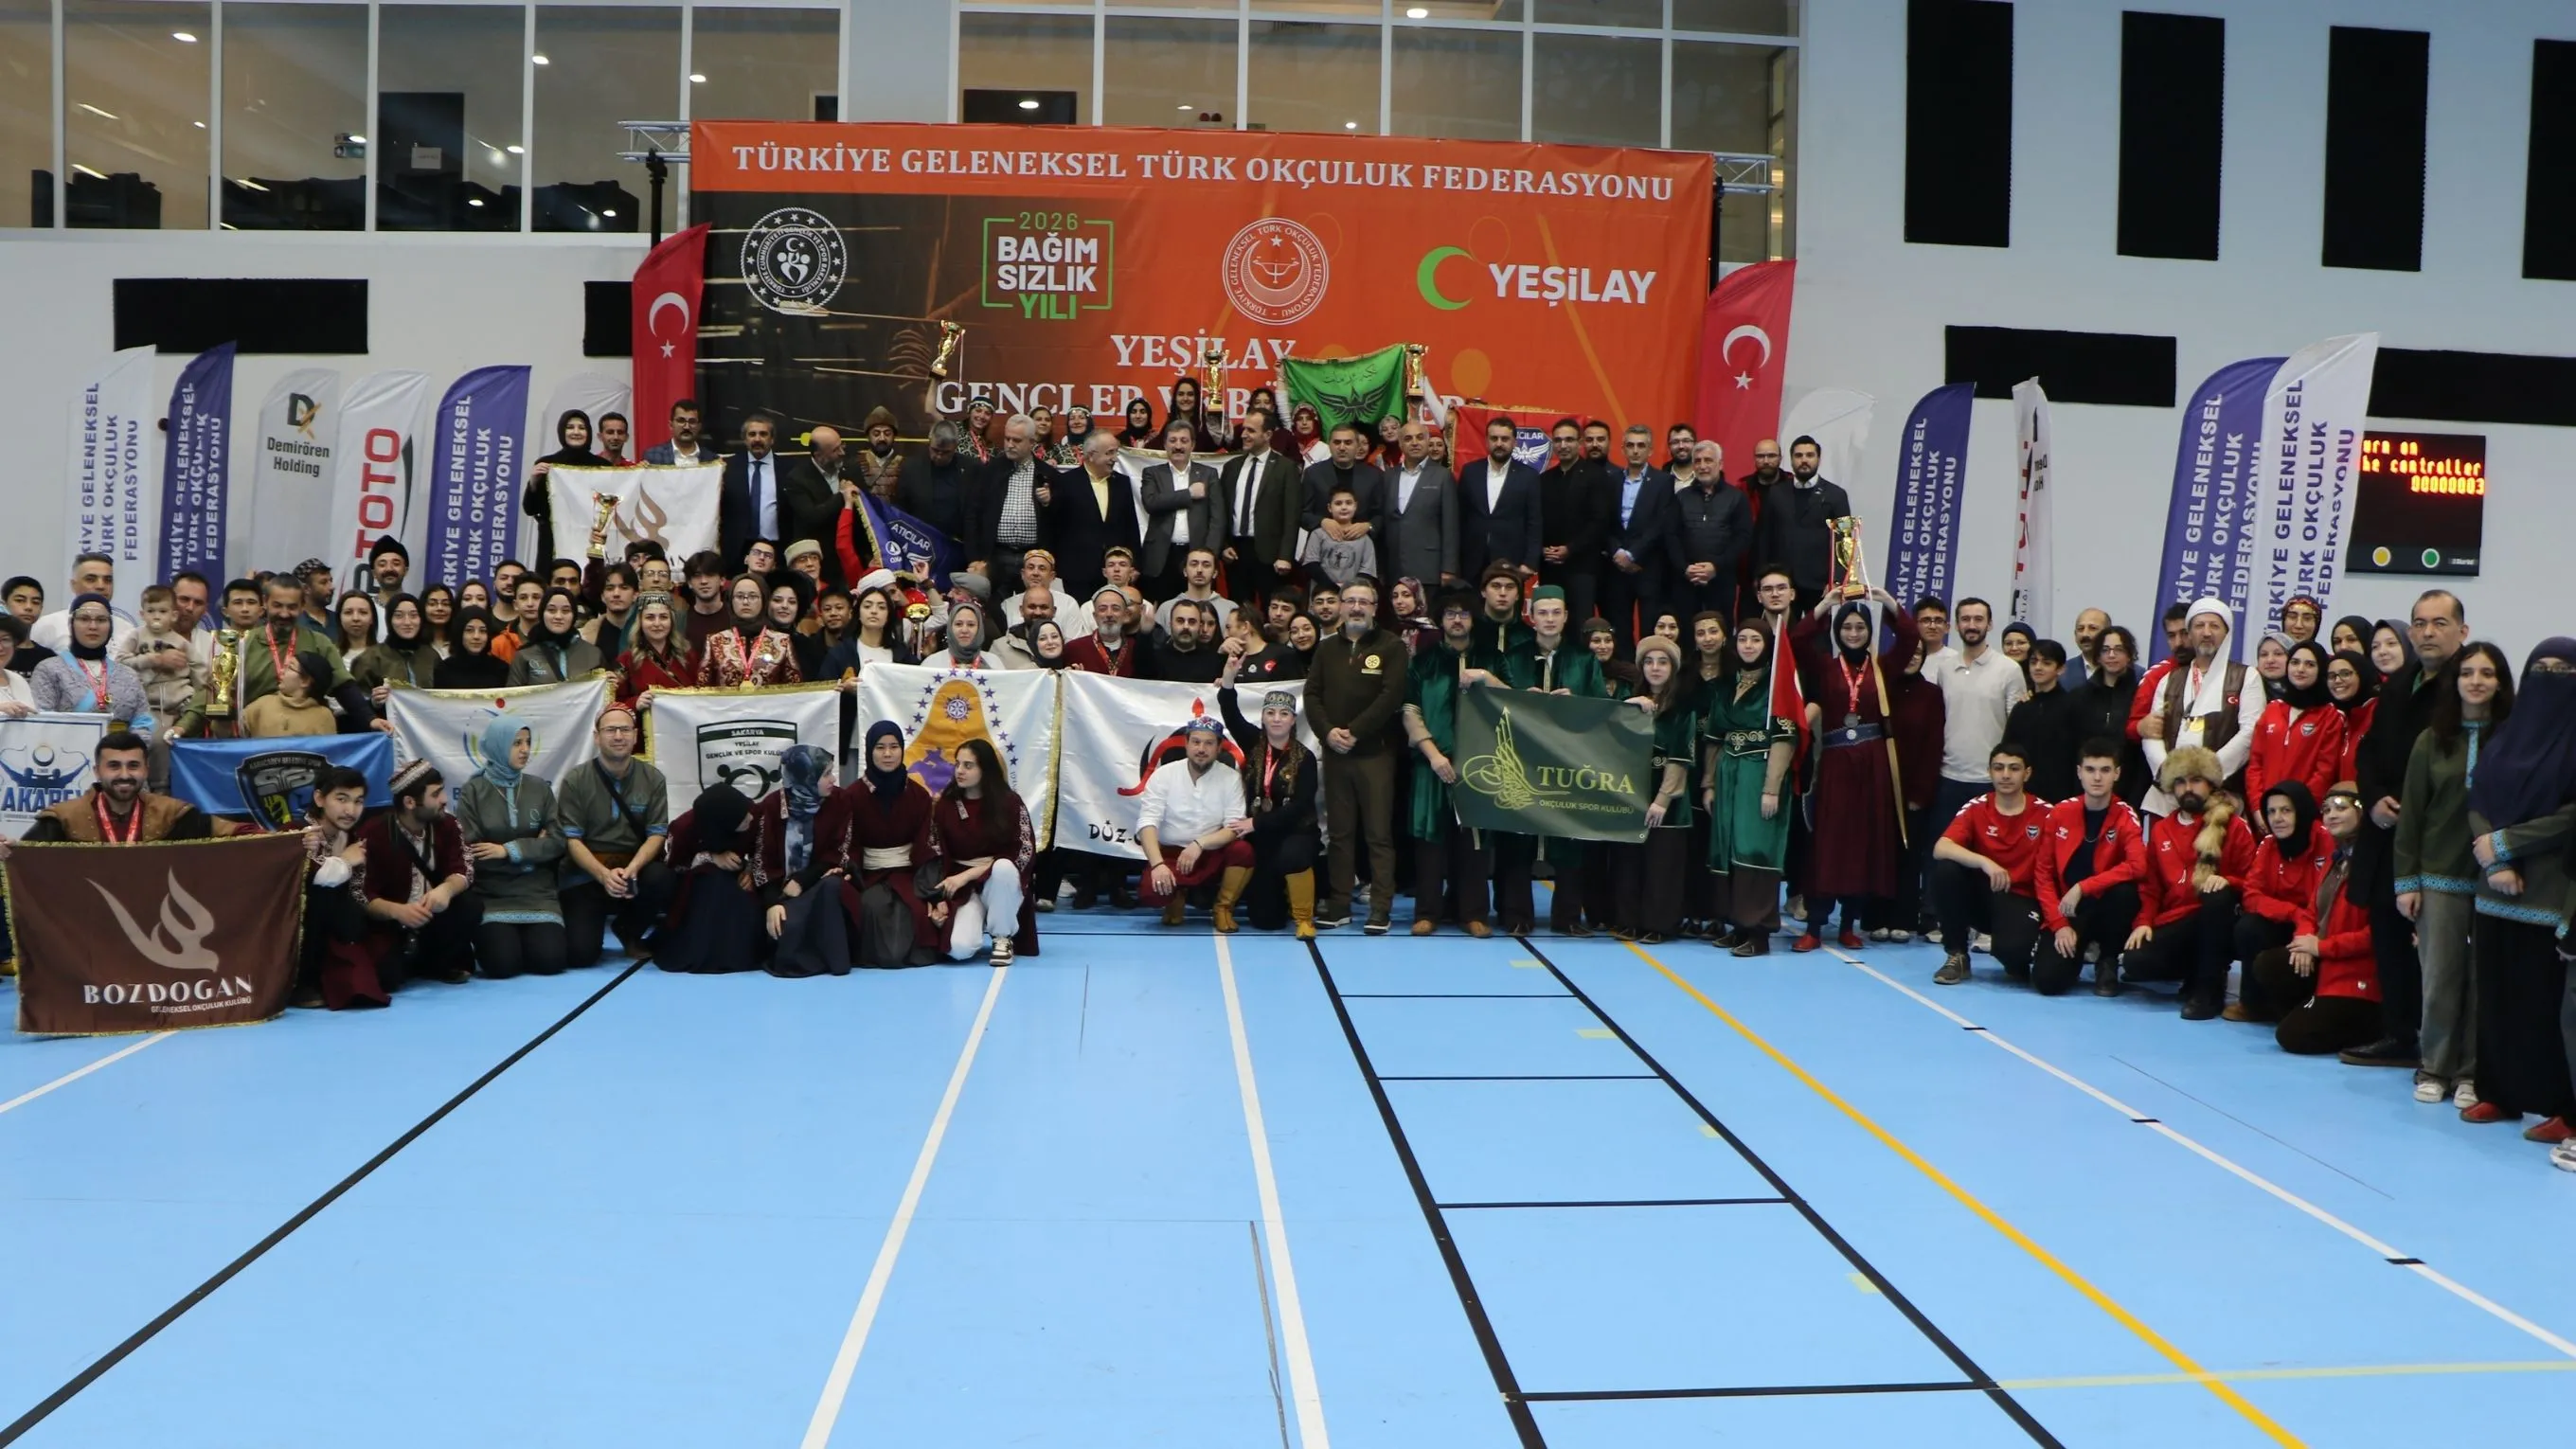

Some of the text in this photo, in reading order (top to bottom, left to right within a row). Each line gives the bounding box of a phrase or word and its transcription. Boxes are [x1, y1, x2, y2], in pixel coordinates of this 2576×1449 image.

[732, 141, 1673, 200] TÜRKİYE GELENEKSEL TÜRK OKÇULUK FEDERASYONU
[997, 232, 1098, 263] BAĞIM
[1019, 211, 1078, 230] 2026
[997, 264, 1097, 292] SIZLIK
[1018, 294, 1077, 319] YILI
[82, 383, 99, 508] GELENEKSEL
[267, 437, 330, 457] Demirören
[273, 456, 320, 477] Holding
[447, 395, 472, 522] GELENEKSEL
[2185, 394, 2223, 544] GELENEKSEL
[2275, 379, 2303, 540] GELENEKSEL
[2389, 456, 2481, 476] controller
[2400, 441, 2419, 456] on
[98, 415, 118, 558] ÜRK OKÇULUK
[124, 420, 139, 561] FEDERASYONU
[206, 418, 222, 561] FEDERASYONU
[464, 427, 492, 581] TÜRK OKÇULUK
[1903, 418, 1928, 546] GELENEKSEL
[1919, 450, 1941, 546] OKÇULUK
[2411, 475, 2485, 495] 00000003
[2201, 432, 2244, 599] ÜRK OKÇULUK
[2292, 421, 2328, 599] ÜRK OKÇULUK
[186, 512, 200, 564] TÜRK
[1537, 763, 1635, 795] TUĞRA
[1579, 802, 1600, 812] SPOR
[192, 1001, 224, 1011] OKÇULUK
